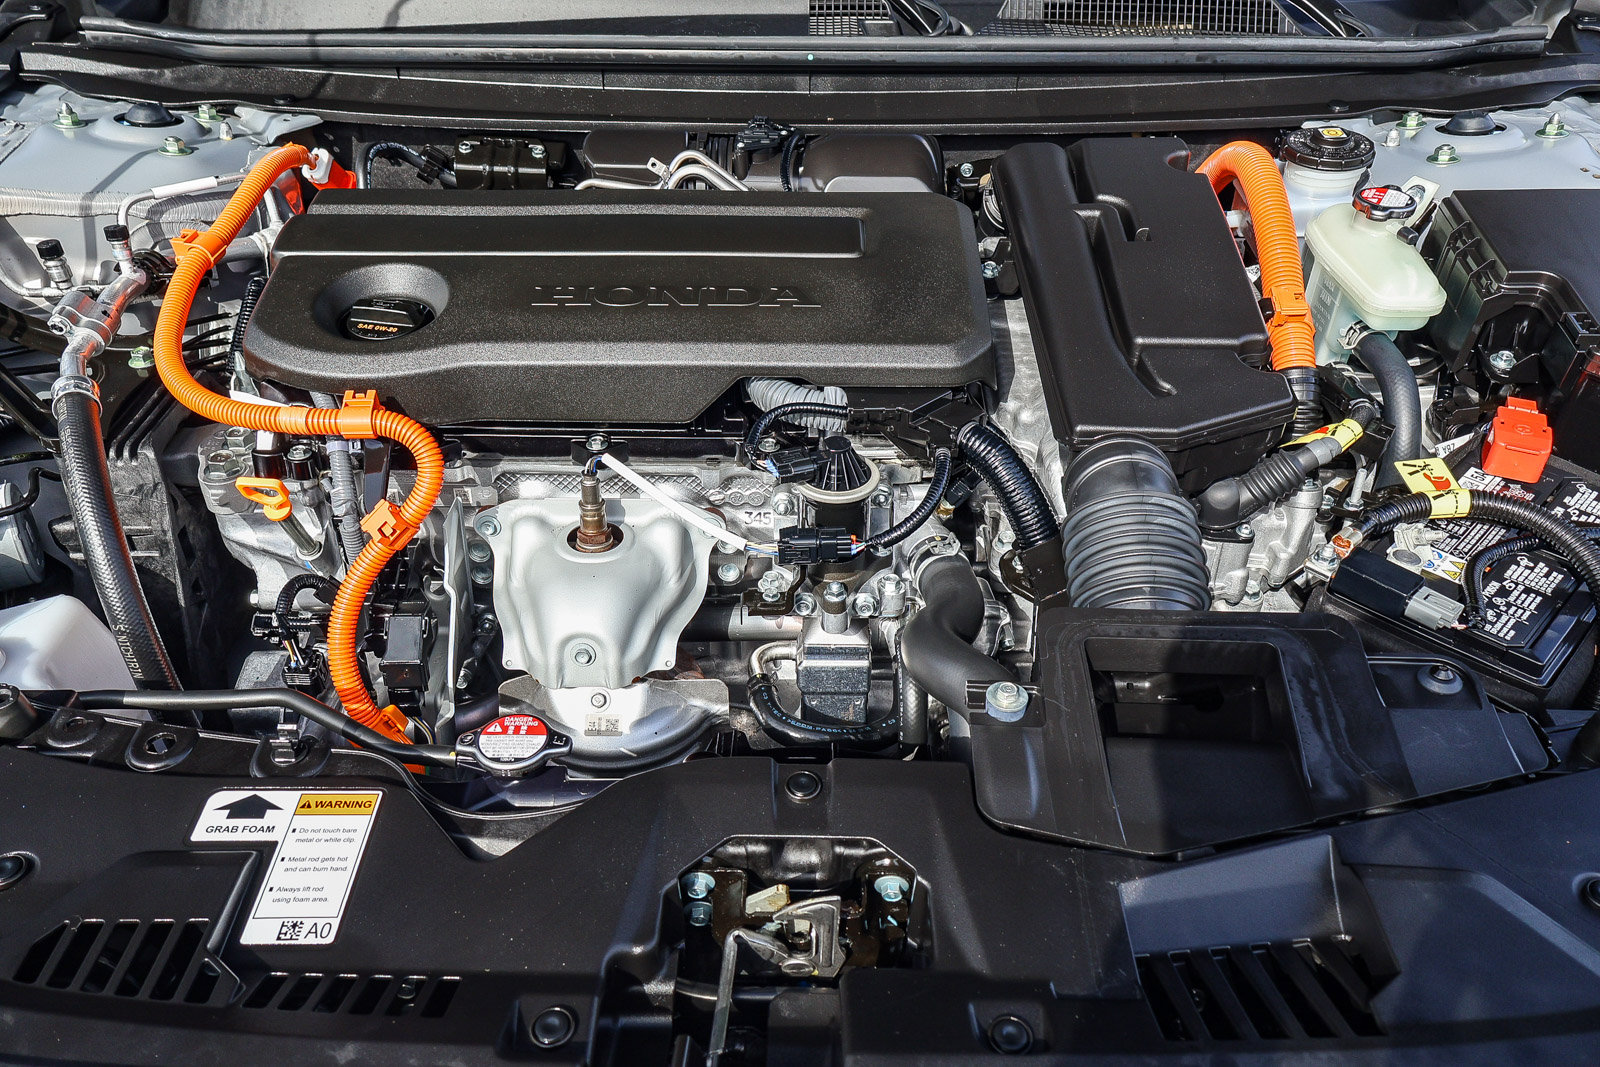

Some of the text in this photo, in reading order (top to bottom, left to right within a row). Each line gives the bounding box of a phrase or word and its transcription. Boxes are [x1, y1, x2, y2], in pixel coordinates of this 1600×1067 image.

[531, 286, 822, 308] HONDA
[374, 325, 398, 333] 0W-20
[744, 511, 771, 525] 345
[315, 800, 373, 809] WARNING
[205, 825, 276, 834] GRAB FOAM
